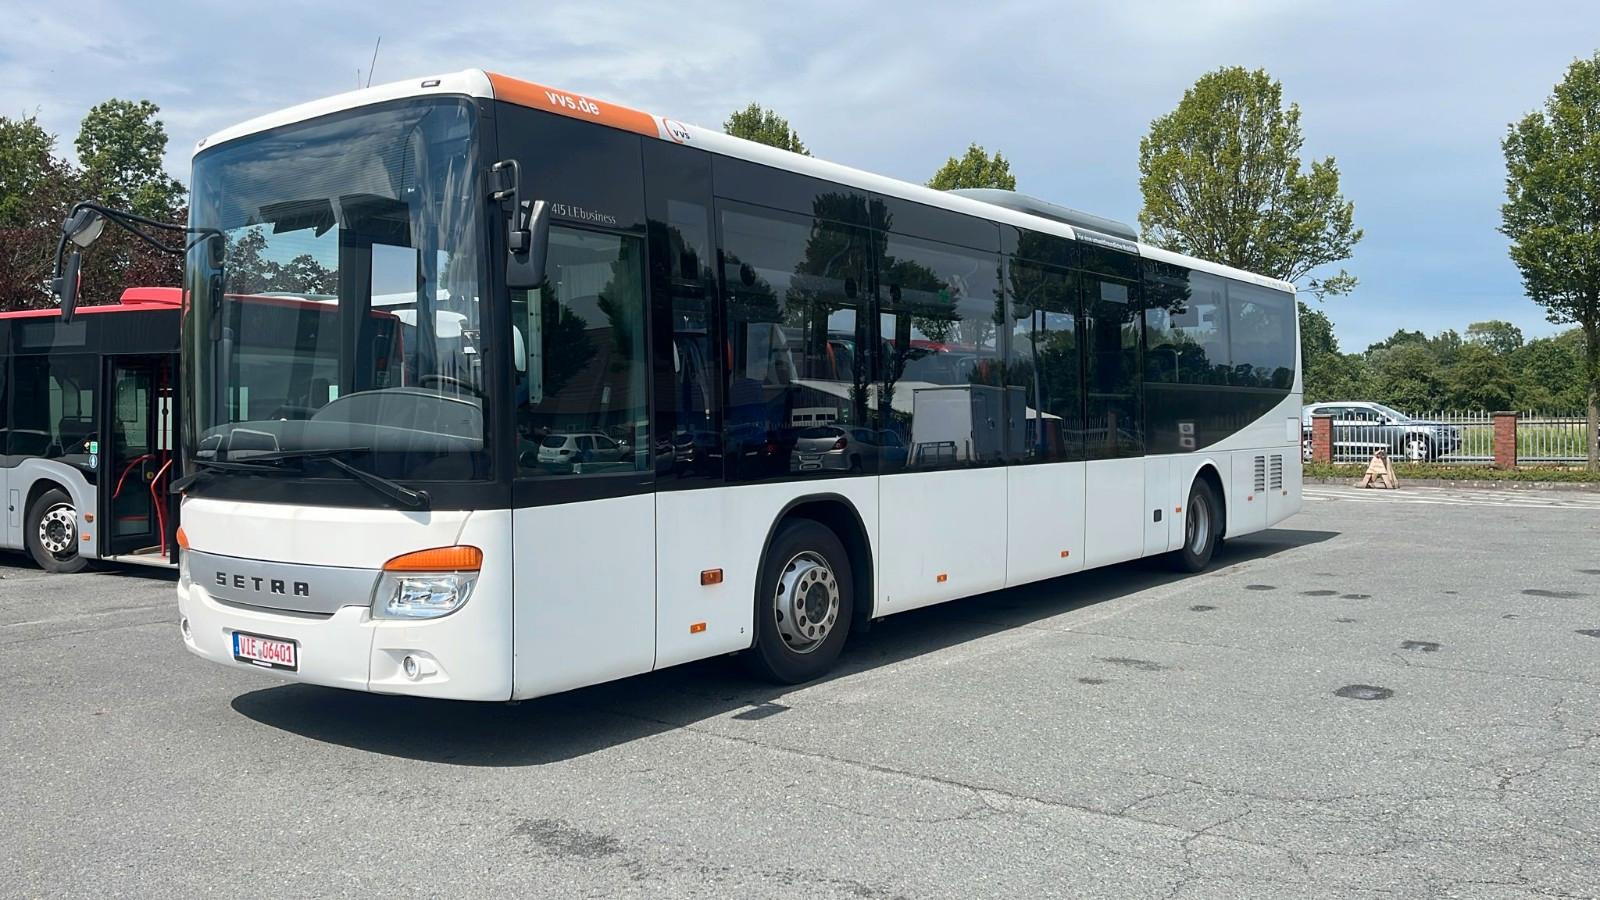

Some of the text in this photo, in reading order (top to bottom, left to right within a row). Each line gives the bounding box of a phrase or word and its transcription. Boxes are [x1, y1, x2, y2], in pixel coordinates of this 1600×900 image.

[545, 91, 600, 116] vvs.de
[551, 203, 566, 216] 415
[216, 571, 309, 596] SETRA
[240, 637, 292, 663] VIE 06401
